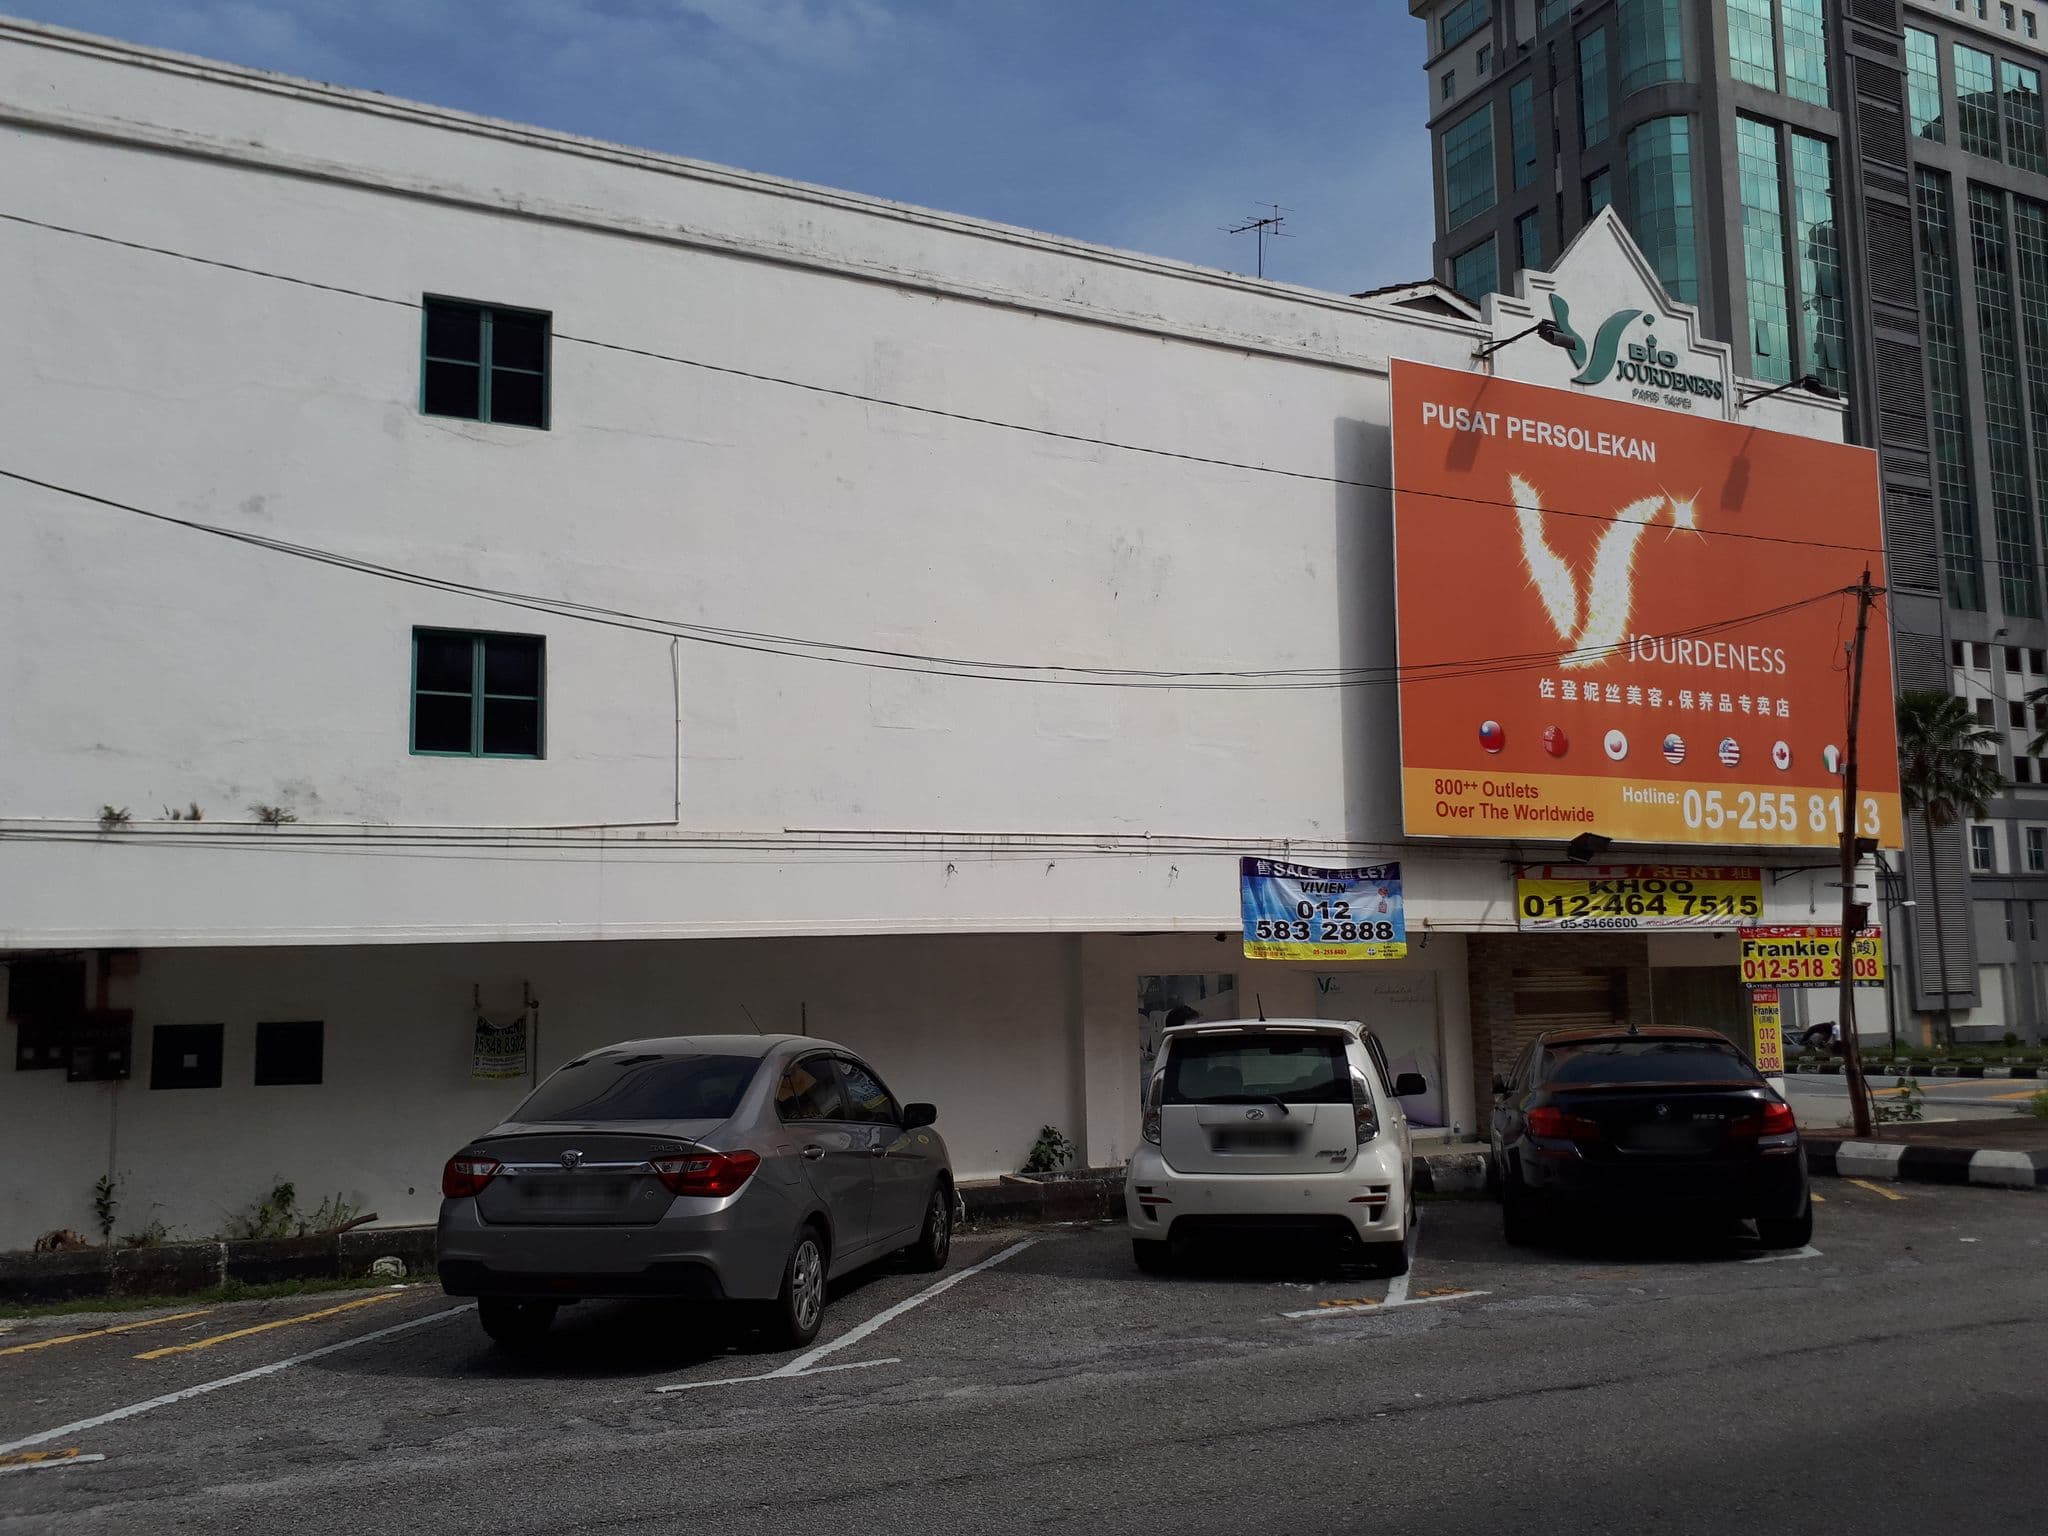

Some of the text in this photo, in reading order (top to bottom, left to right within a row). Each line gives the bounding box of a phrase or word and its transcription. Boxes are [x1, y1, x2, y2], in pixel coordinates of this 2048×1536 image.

[1616, 360, 1722, 399] JOURDENESS
[1422, 401, 1656, 463] PUSAT PERSOLEKAN
[1628, 632, 1786, 675] JOURDENESS
[1435, 778, 1539, 798] 800++ Outlets
[1622, 786, 1680, 805] Hotline:
[1436, 801, 1595, 822] Over The Worldwide
[1683, 788, 1881, 835] 05-255 813
[1273, 864, 1321, 879] SALE
[1358, 866, 1388, 879] LET
[1653, 867, 1723, 879] RENT
[1300, 881, 1346, 894] VIVIEN
[1589, 880, 1693, 896] KHOO
[1296, 900, 1352, 920] 012
[1523, 894, 1758, 917] 012-464 7515
[1256, 920, 1395, 942] 583 2888
[1560, 917, 1638, 930] 05-5466600
[1743, 941, 1829, 957] Frankie
[1743, 958, 1877, 979] 012-518 308
[1753, 1005, 1779, 1016] Frankie
[1759, 1028, 1776, 1040] 012
[1760, 1043, 1777, 1055] 518
[1758, 1057, 1780, 1070] 3008
